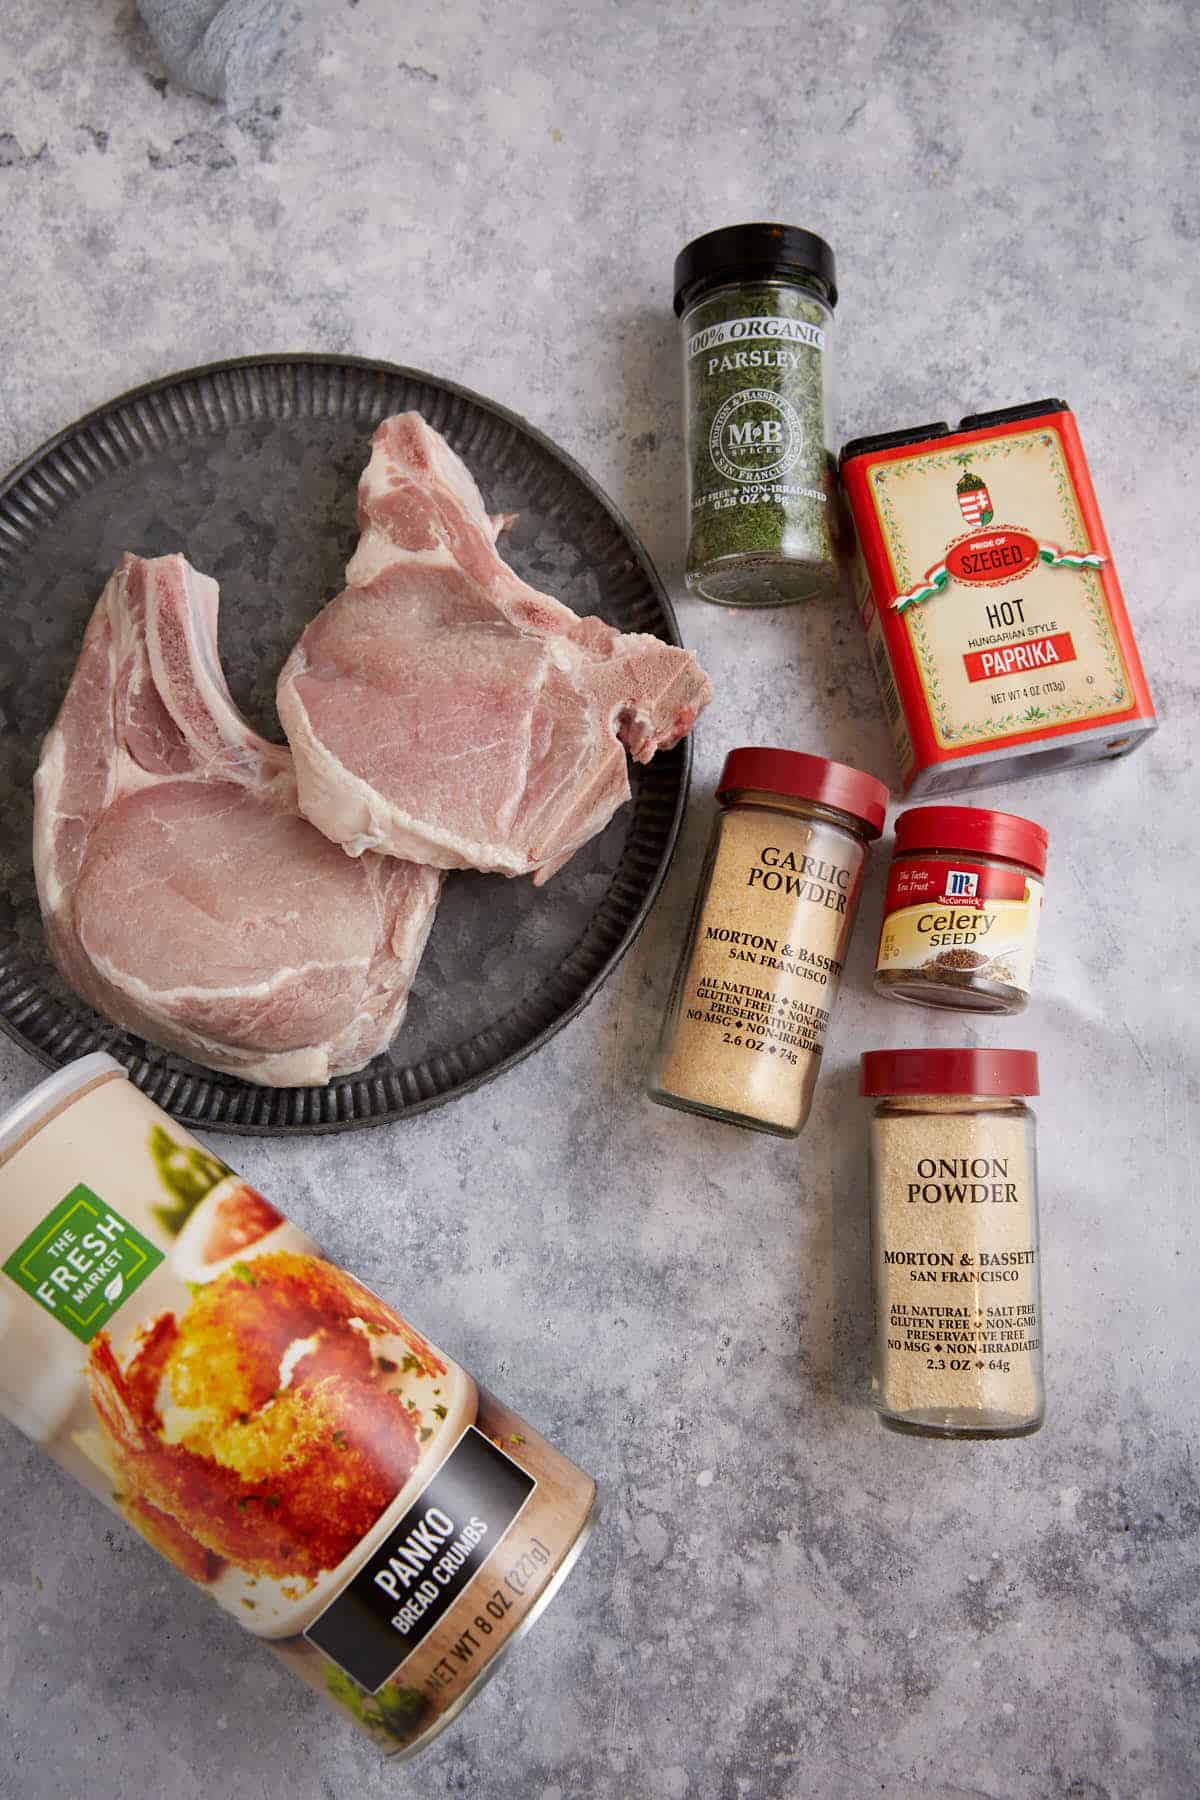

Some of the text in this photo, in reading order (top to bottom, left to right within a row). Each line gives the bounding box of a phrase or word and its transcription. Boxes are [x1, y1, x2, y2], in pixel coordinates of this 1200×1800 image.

[730, 320, 824, 345] ORGANIC
[708, 350, 801, 376] PARSLEY
[740, 494, 759, 504] OZ
[961, 545, 1023, 575] SZEGED
[986, 599, 1025, 629] HOT
[968, 621, 1058, 648] HUNGARIAN STYLE
[981, 640, 1059, 676] PAPRIKA
[990, 680, 1066, 704] NET WT 4 OZ (113g)
[760, 846, 851, 889] GARLIC
[747, 868, 848, 914] POWDER
[917, 910, 997, 935] Celery
[705, 927, 779, 953] MORTON
[781, 944, 794, 957] &
[929, 932, 977, 947] SEED
[728, 948, 827, 985] SAN FRANCISCO
[696, 988, 743, 1005] GLUTEN
[744, 997, 776, 1014] FREE
[699, 977, 721, 989] ALL
[721, 981, 778, 1003] NATURAL
[791, 999, 815, 1015] SALT
[686, 1009, 702, 1019] NO
[704, 1013, 732, 1027] MSG
[710, 1001, 818, 1041] PRESERVATIVE FREE
[722, 1033, 799, 1065] 2.6 OZ 74g
[917, 1158, 1009, 1179] ONION
[907, 1183, 1018, 1204] POWDER
[47, 1229, 77, 1258] THE
[36, 1214, 125, 1308] FRESH
[884, 1250, 1035, 1266] MORTON & BASSETT
[72, 1248, 124, 1304] MARKET
[910, 1271, 1019, 1283] SAN FRANCISCO
[890, 1304, 1036, 1317] ALL NATURAL SALT FREE
[890, 1316, 1036, 1329] GLUTEN FREE NON-GMO
[888, 1339, 902, 1350] NO
[904, 1342, 930, 1352] MSG
[907, 1329, 1025, 1342] PRESERVATIVE FREE
[927, 1359, 1010, 1372] 2.3 OZ 64g
[374, 1507, 455, 1600] PANKO
[391, 1516, 489, 1635] BREAD CRUMBS
[424, 1538, 552, 1693] NET WT 8 OZ (227g)
